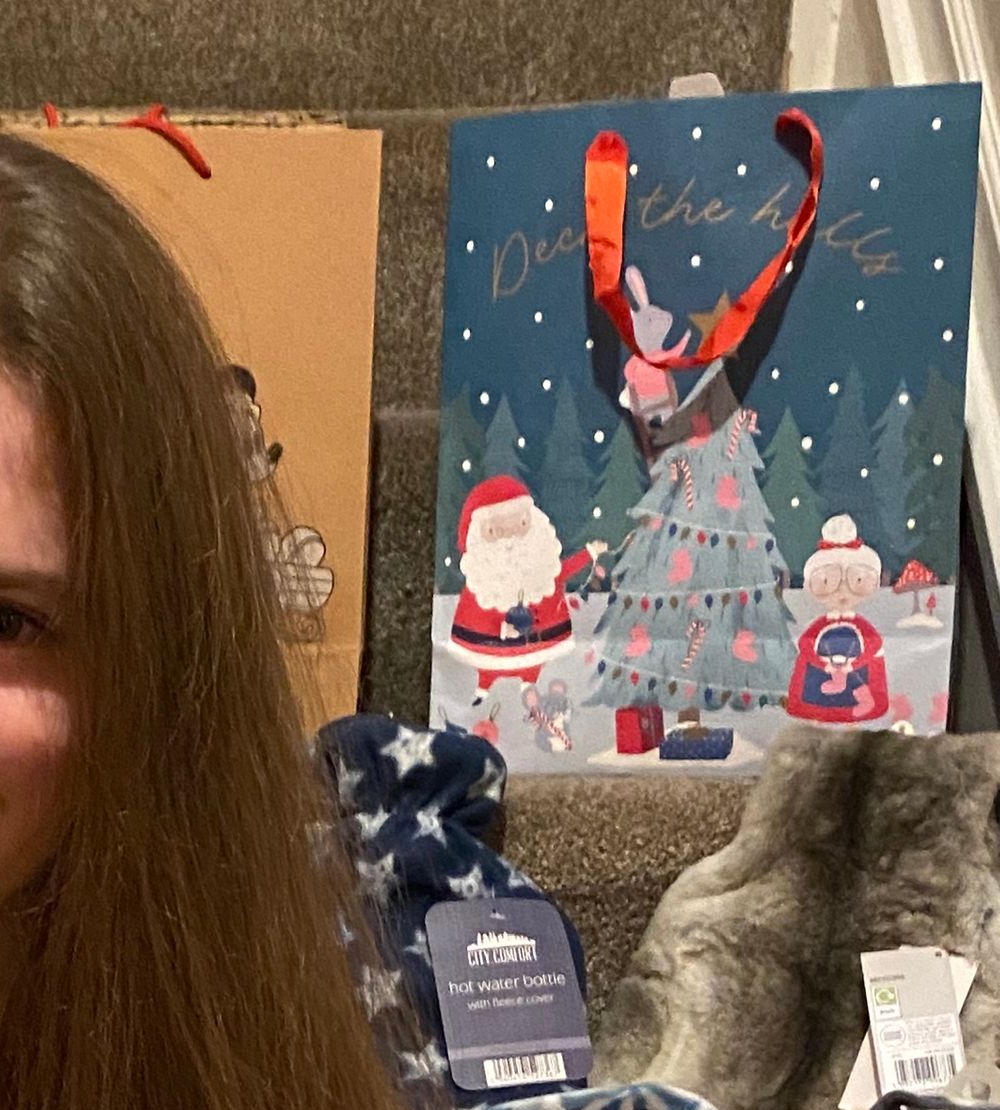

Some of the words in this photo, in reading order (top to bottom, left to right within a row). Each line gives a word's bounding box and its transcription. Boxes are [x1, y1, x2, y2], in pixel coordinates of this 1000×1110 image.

[491, 230, 590, 302] Dec
[638, 177, 737, 231] the
[466, 949, 490, 967] CITY
[492, 944, 538, 965] COMFORT
[448, 980, 474, 995] hot
[478, 977, 520, 993] water
[523, 971, 567, 987] bottle
